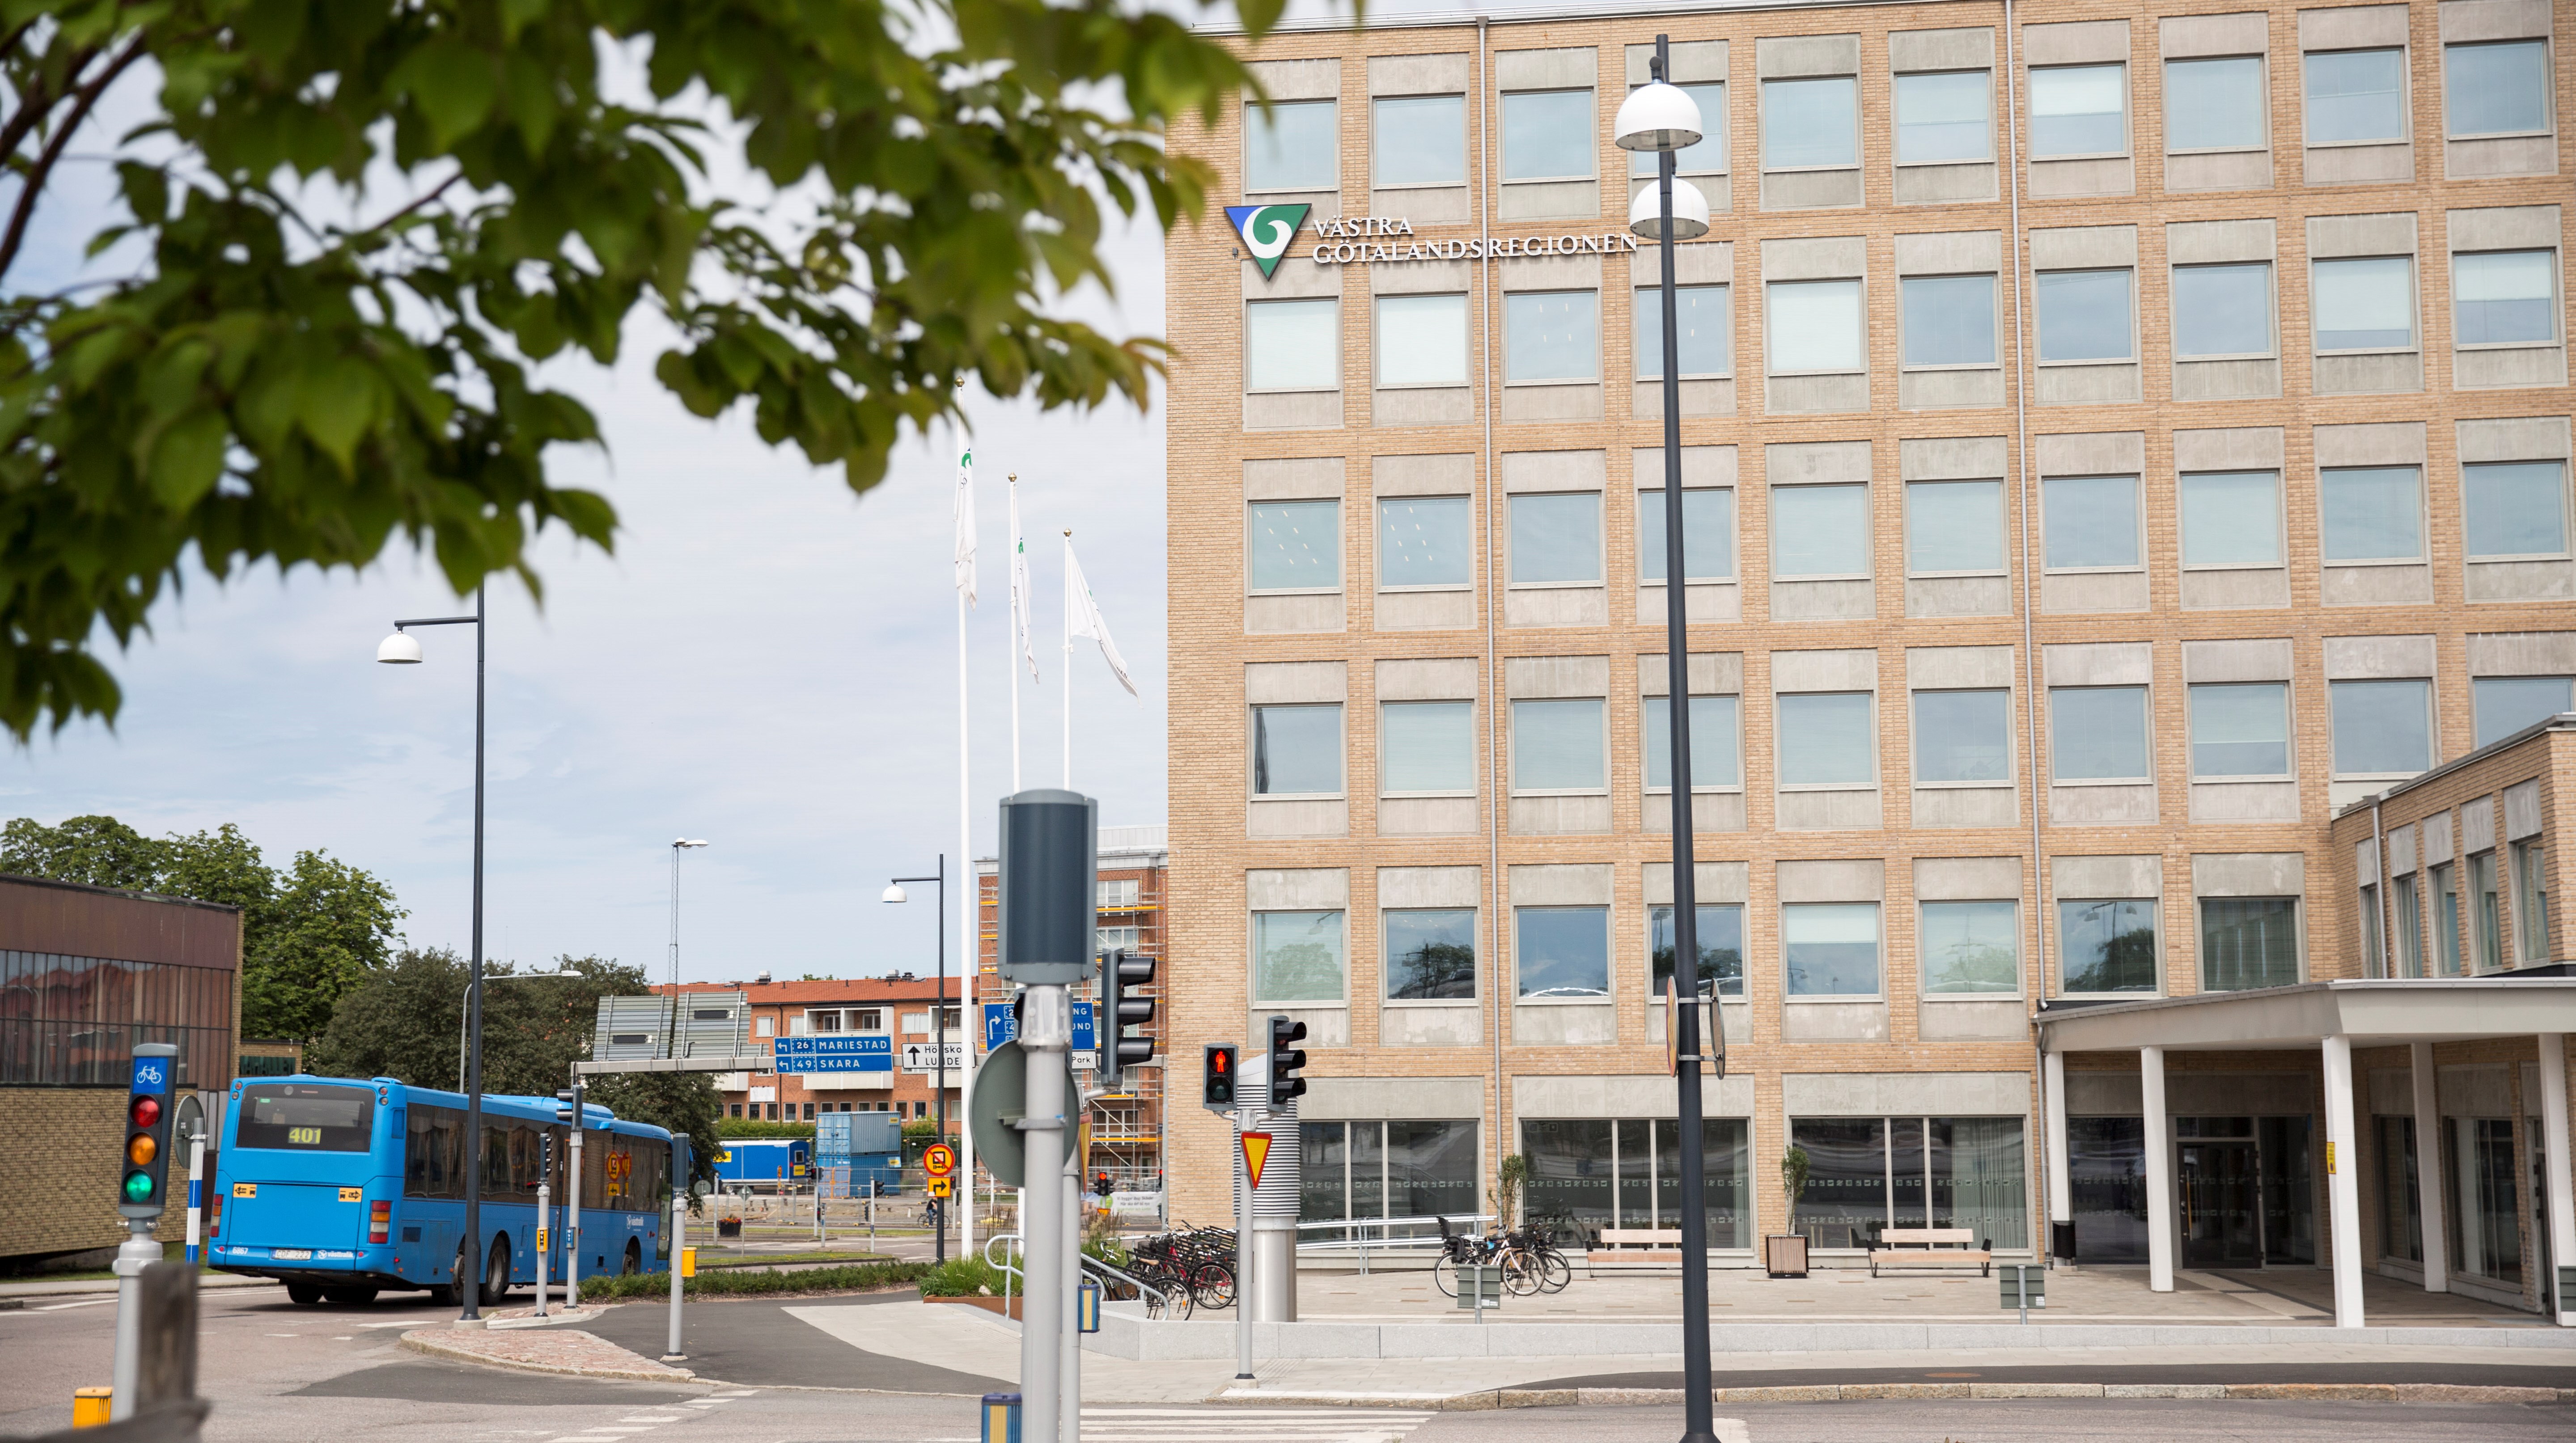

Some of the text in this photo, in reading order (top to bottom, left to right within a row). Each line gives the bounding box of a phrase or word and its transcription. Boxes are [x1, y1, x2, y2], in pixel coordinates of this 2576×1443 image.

[1313, 215, 1414, 238] VÄSTRA
[1313, 233, 1637, 263] GÖTALANDSREGIONEN
[819, 1040, 887, 1050] MARIESTAD
[925, 1045, 962, 1053] Hösko
[797, 1059, 860, 1069] 49 SKARA
[926, 1057, 959, 1065] LUDE
[289, 1127, 322, 1144] 401
